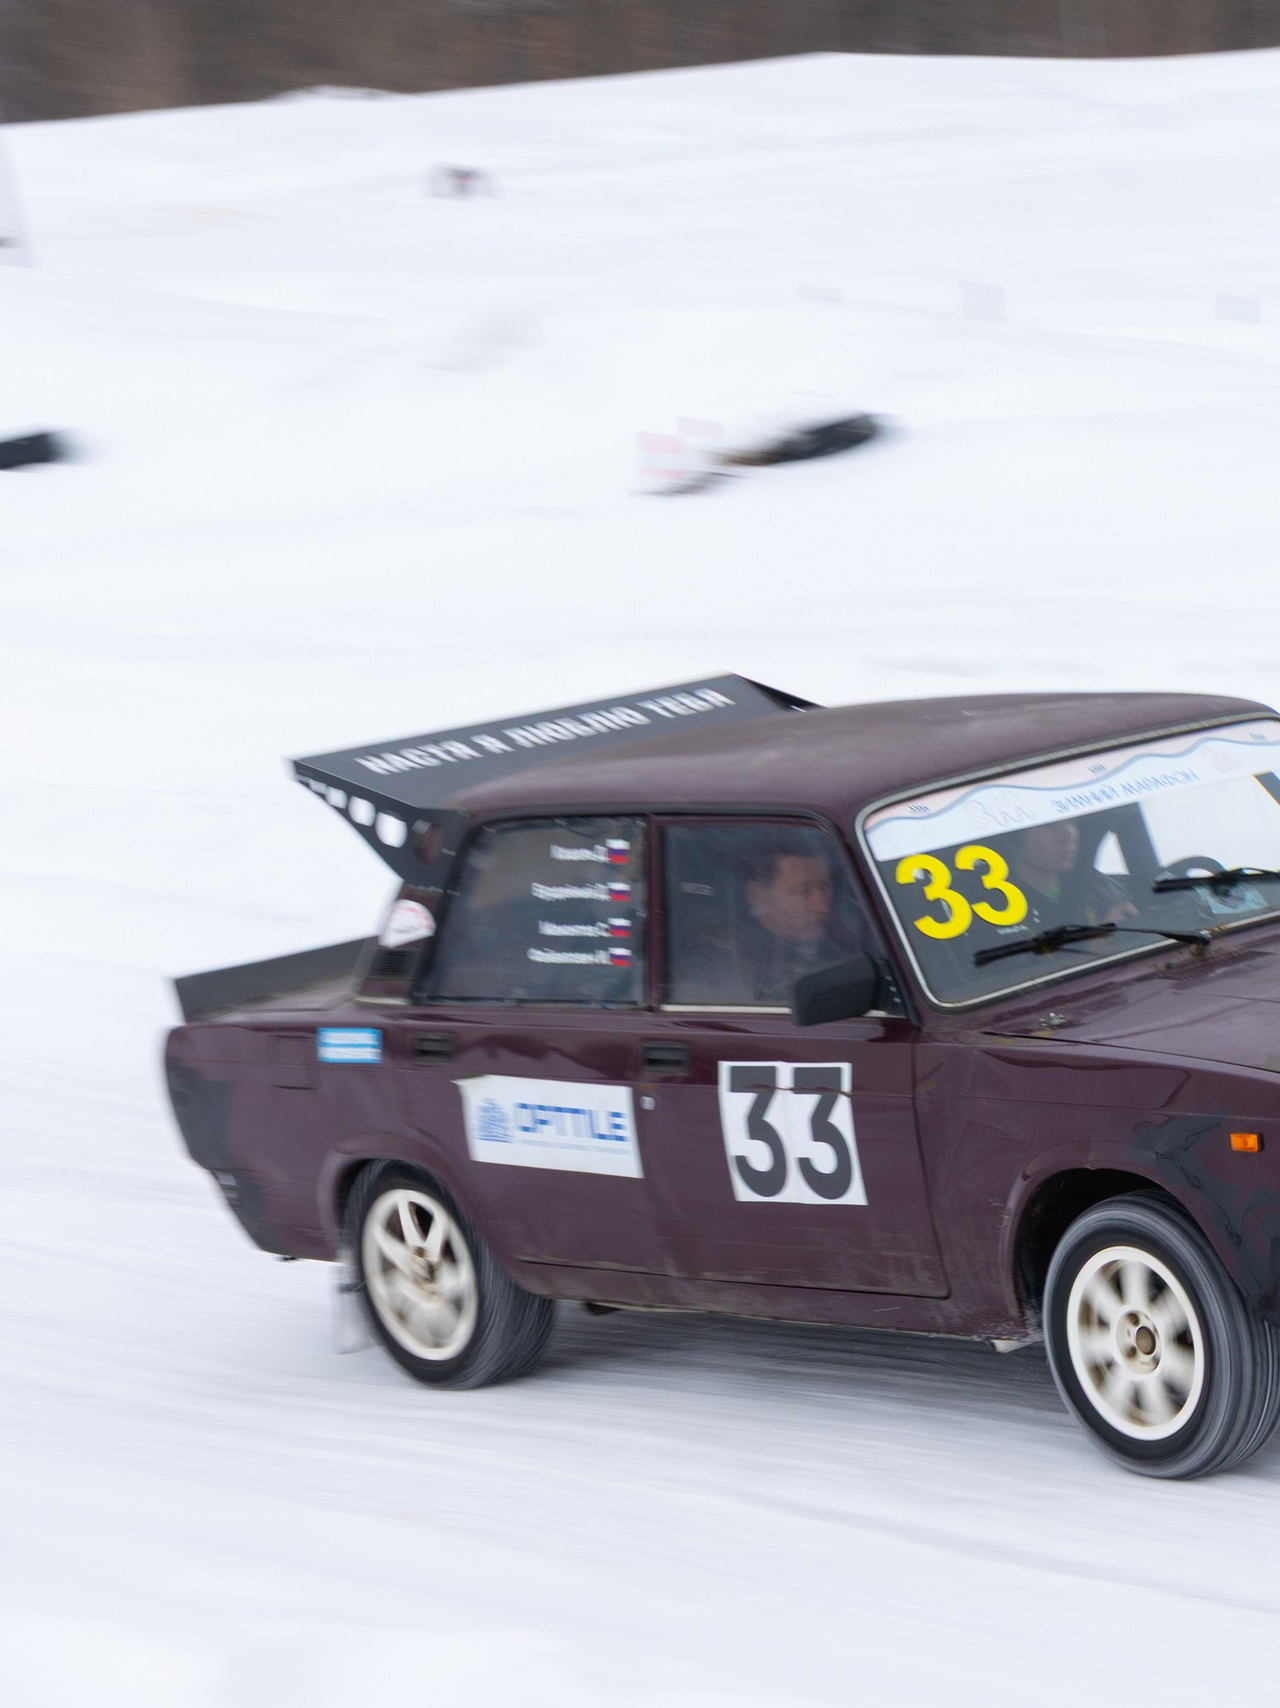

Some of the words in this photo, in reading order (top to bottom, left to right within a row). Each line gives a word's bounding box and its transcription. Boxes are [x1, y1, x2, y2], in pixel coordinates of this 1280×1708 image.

[501, 706, 652, 749] ЛЮБЛЮ
[635, 687, 738, 719] ТЕБЯ
[895, 844, 1028, 940] 33
[729, 1065, 853, 1200] 33
